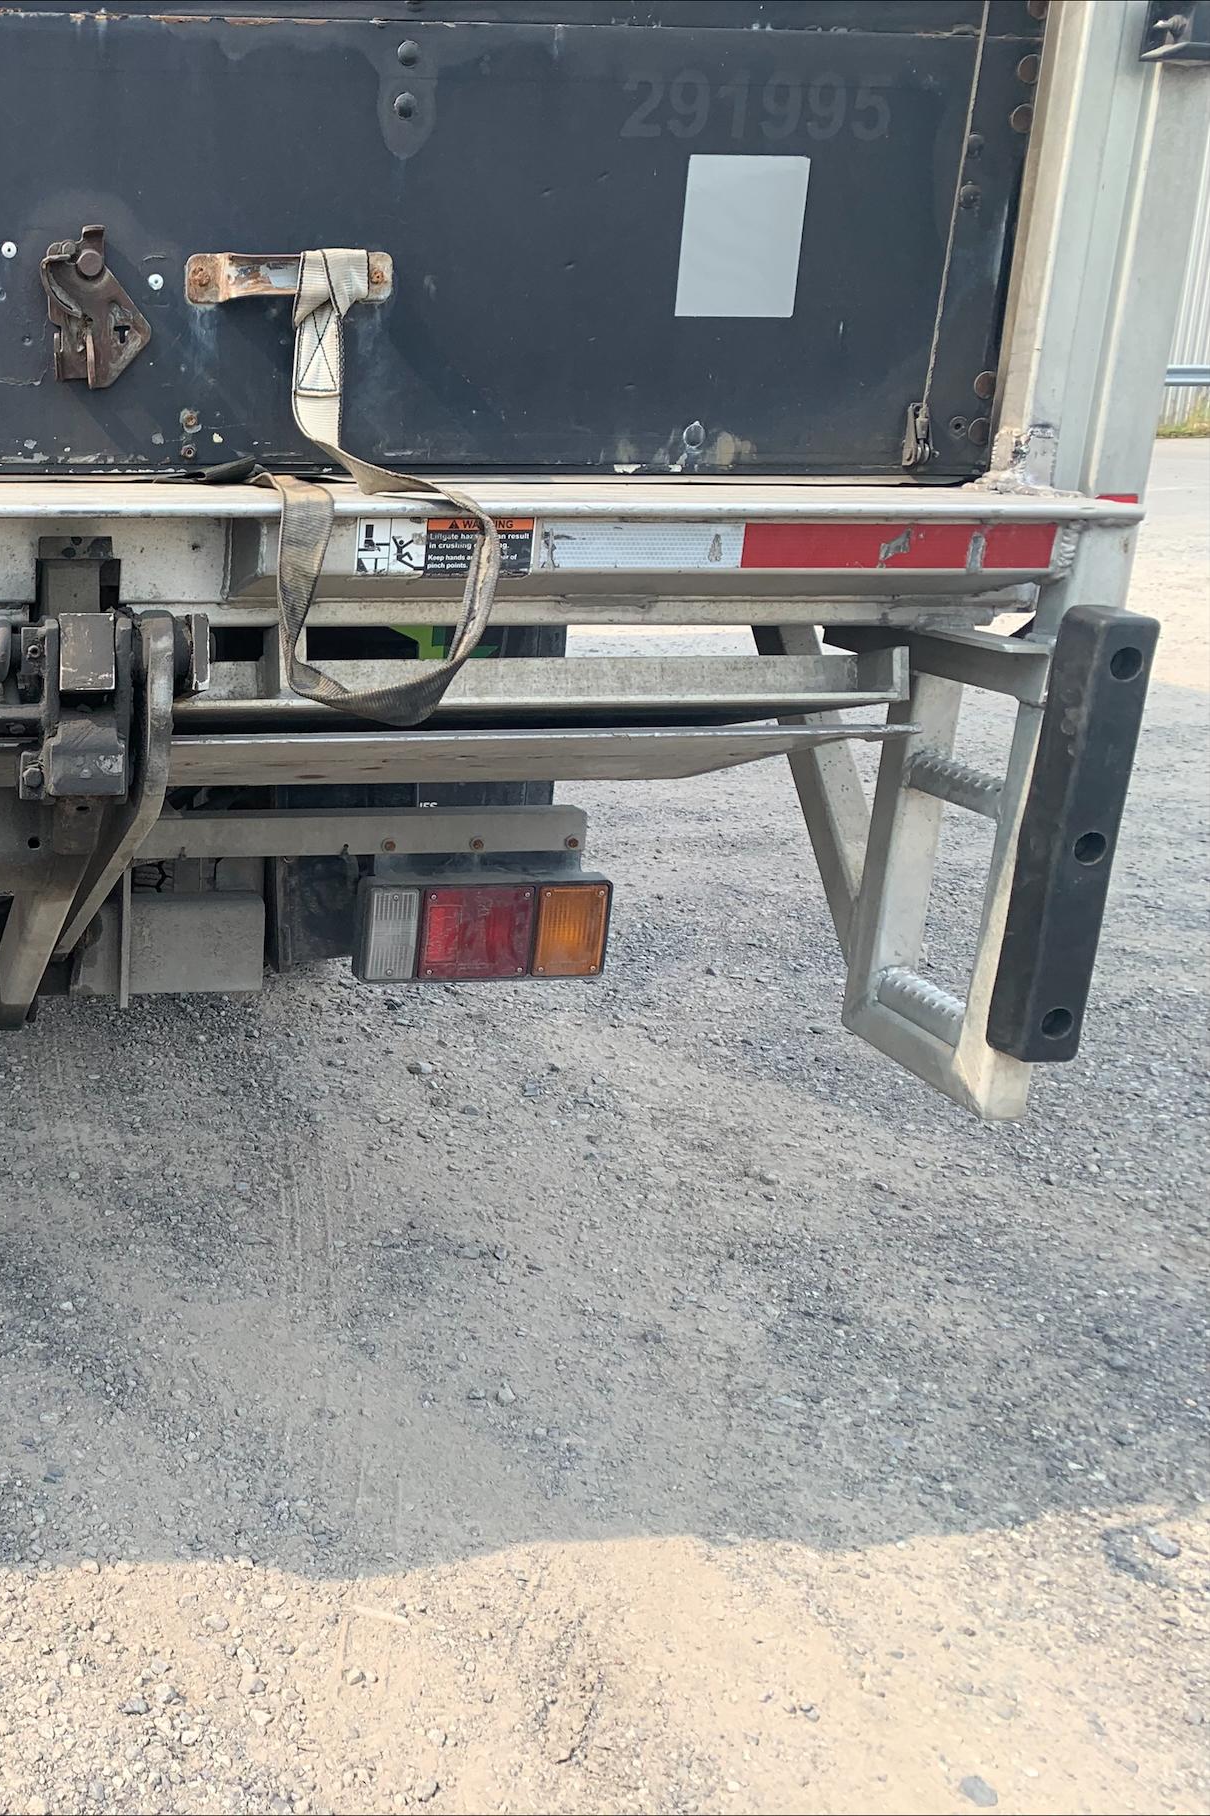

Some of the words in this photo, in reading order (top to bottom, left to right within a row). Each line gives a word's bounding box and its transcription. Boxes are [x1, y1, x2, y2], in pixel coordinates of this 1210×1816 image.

[619, 69, 891, 141] 291995
[462, 520, 514, 529] WAING
[429, 533, 459, 541] Liftgate
[438, 542, 472, 550] crushing
[428, 554, 445, 562] Keep
